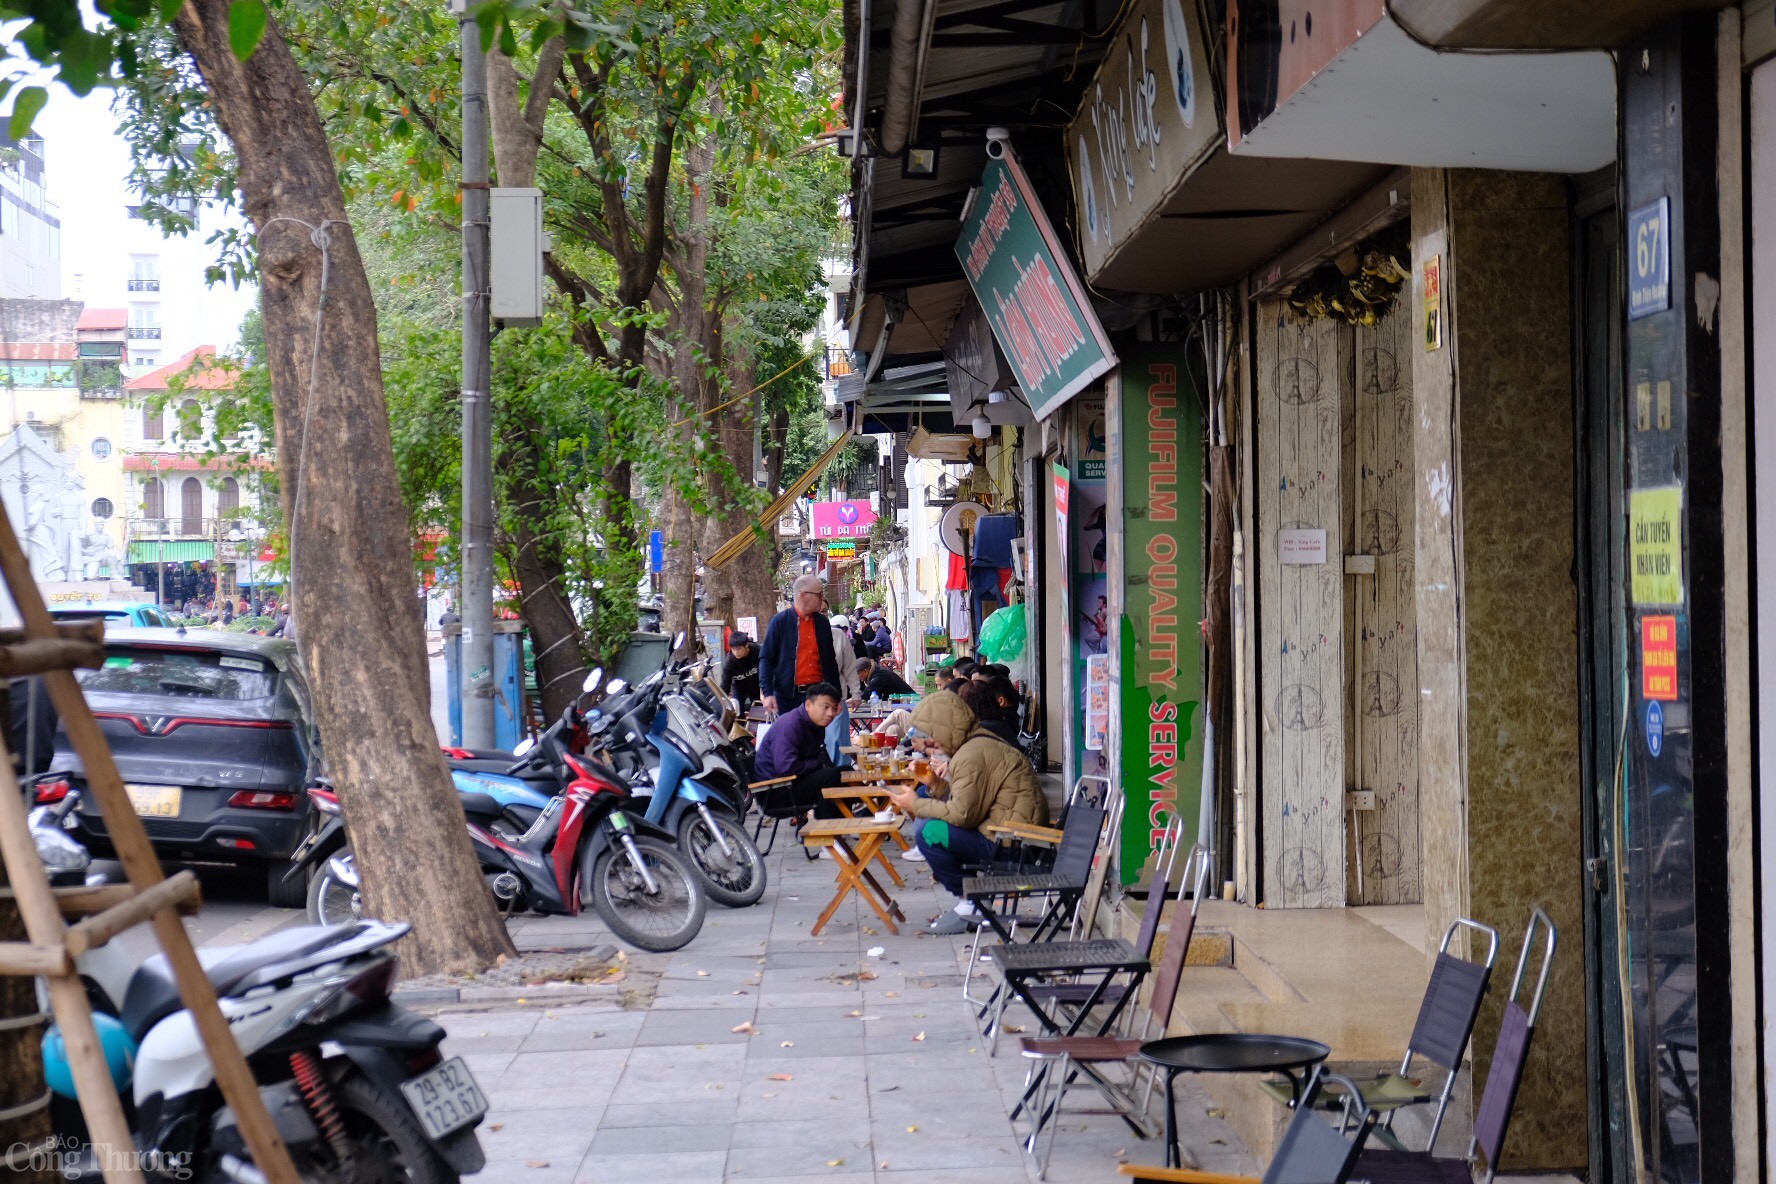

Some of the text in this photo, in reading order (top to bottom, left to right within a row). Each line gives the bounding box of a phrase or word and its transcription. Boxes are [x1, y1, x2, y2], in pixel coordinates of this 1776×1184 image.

[1637, 217, 1659, 278] 67
[993, 287, 1051, 395] LÂM
[1012, 252, 1086, 380] HÙNG
[819, 524, 832, 536] TÚI
[838, 525, 850, 535] DA
[1145, 363, 1178, 858] FUJIFILM QUALITY SERVICE
[513, 854, 541, 868] HONDA
[414, 1064, 465, 1106] 29-B2
[425, 1086, 480, 1133] 123.67
